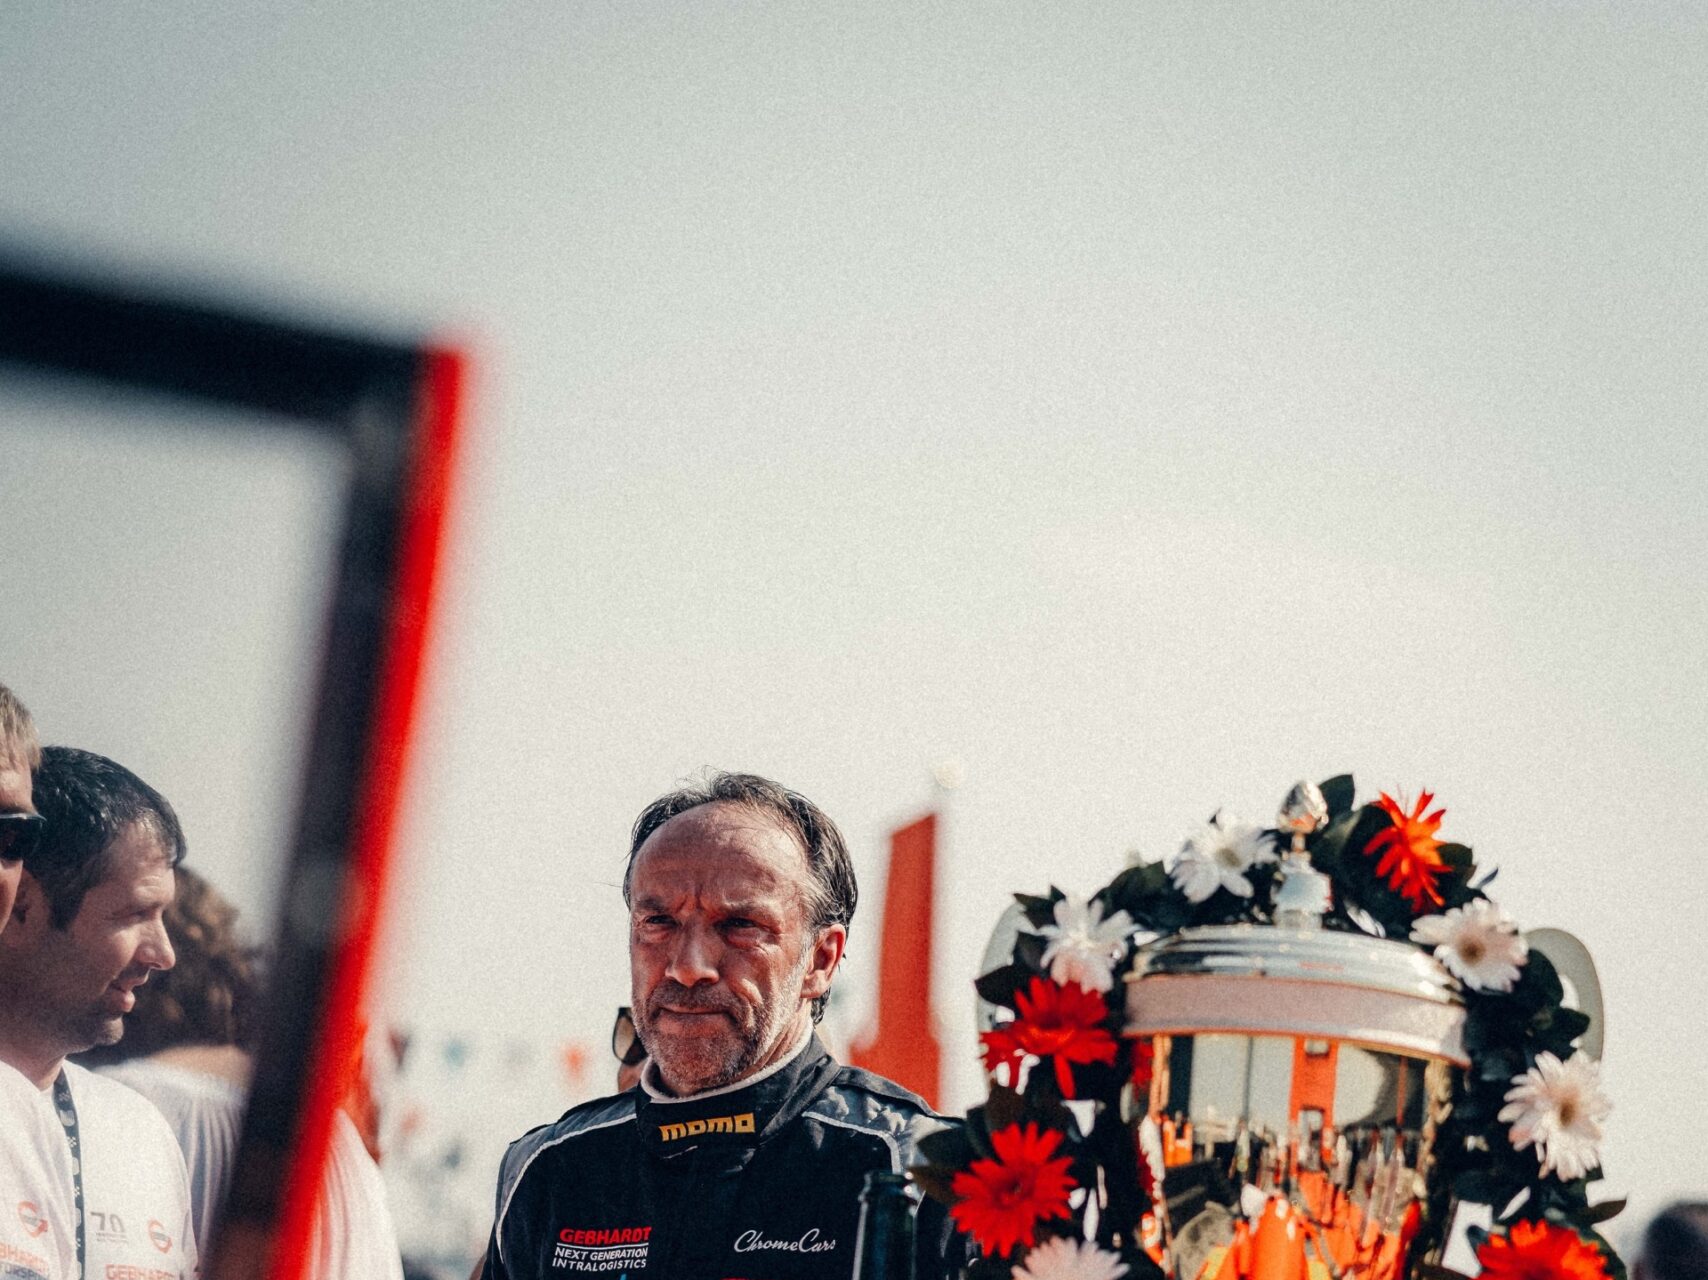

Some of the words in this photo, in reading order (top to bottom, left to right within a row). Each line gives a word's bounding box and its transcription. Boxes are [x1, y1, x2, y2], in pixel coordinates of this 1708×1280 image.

[560, 1226, 652, 1246] GEBHARDT
[734, 1228, 836, 1252] ChromeCars
[554, 1246, 588, 1260] NEXT
[590, 1247, 648, 1261] GENERATION
[552, 1257, 647, 1272] INTRALOGISTICS
